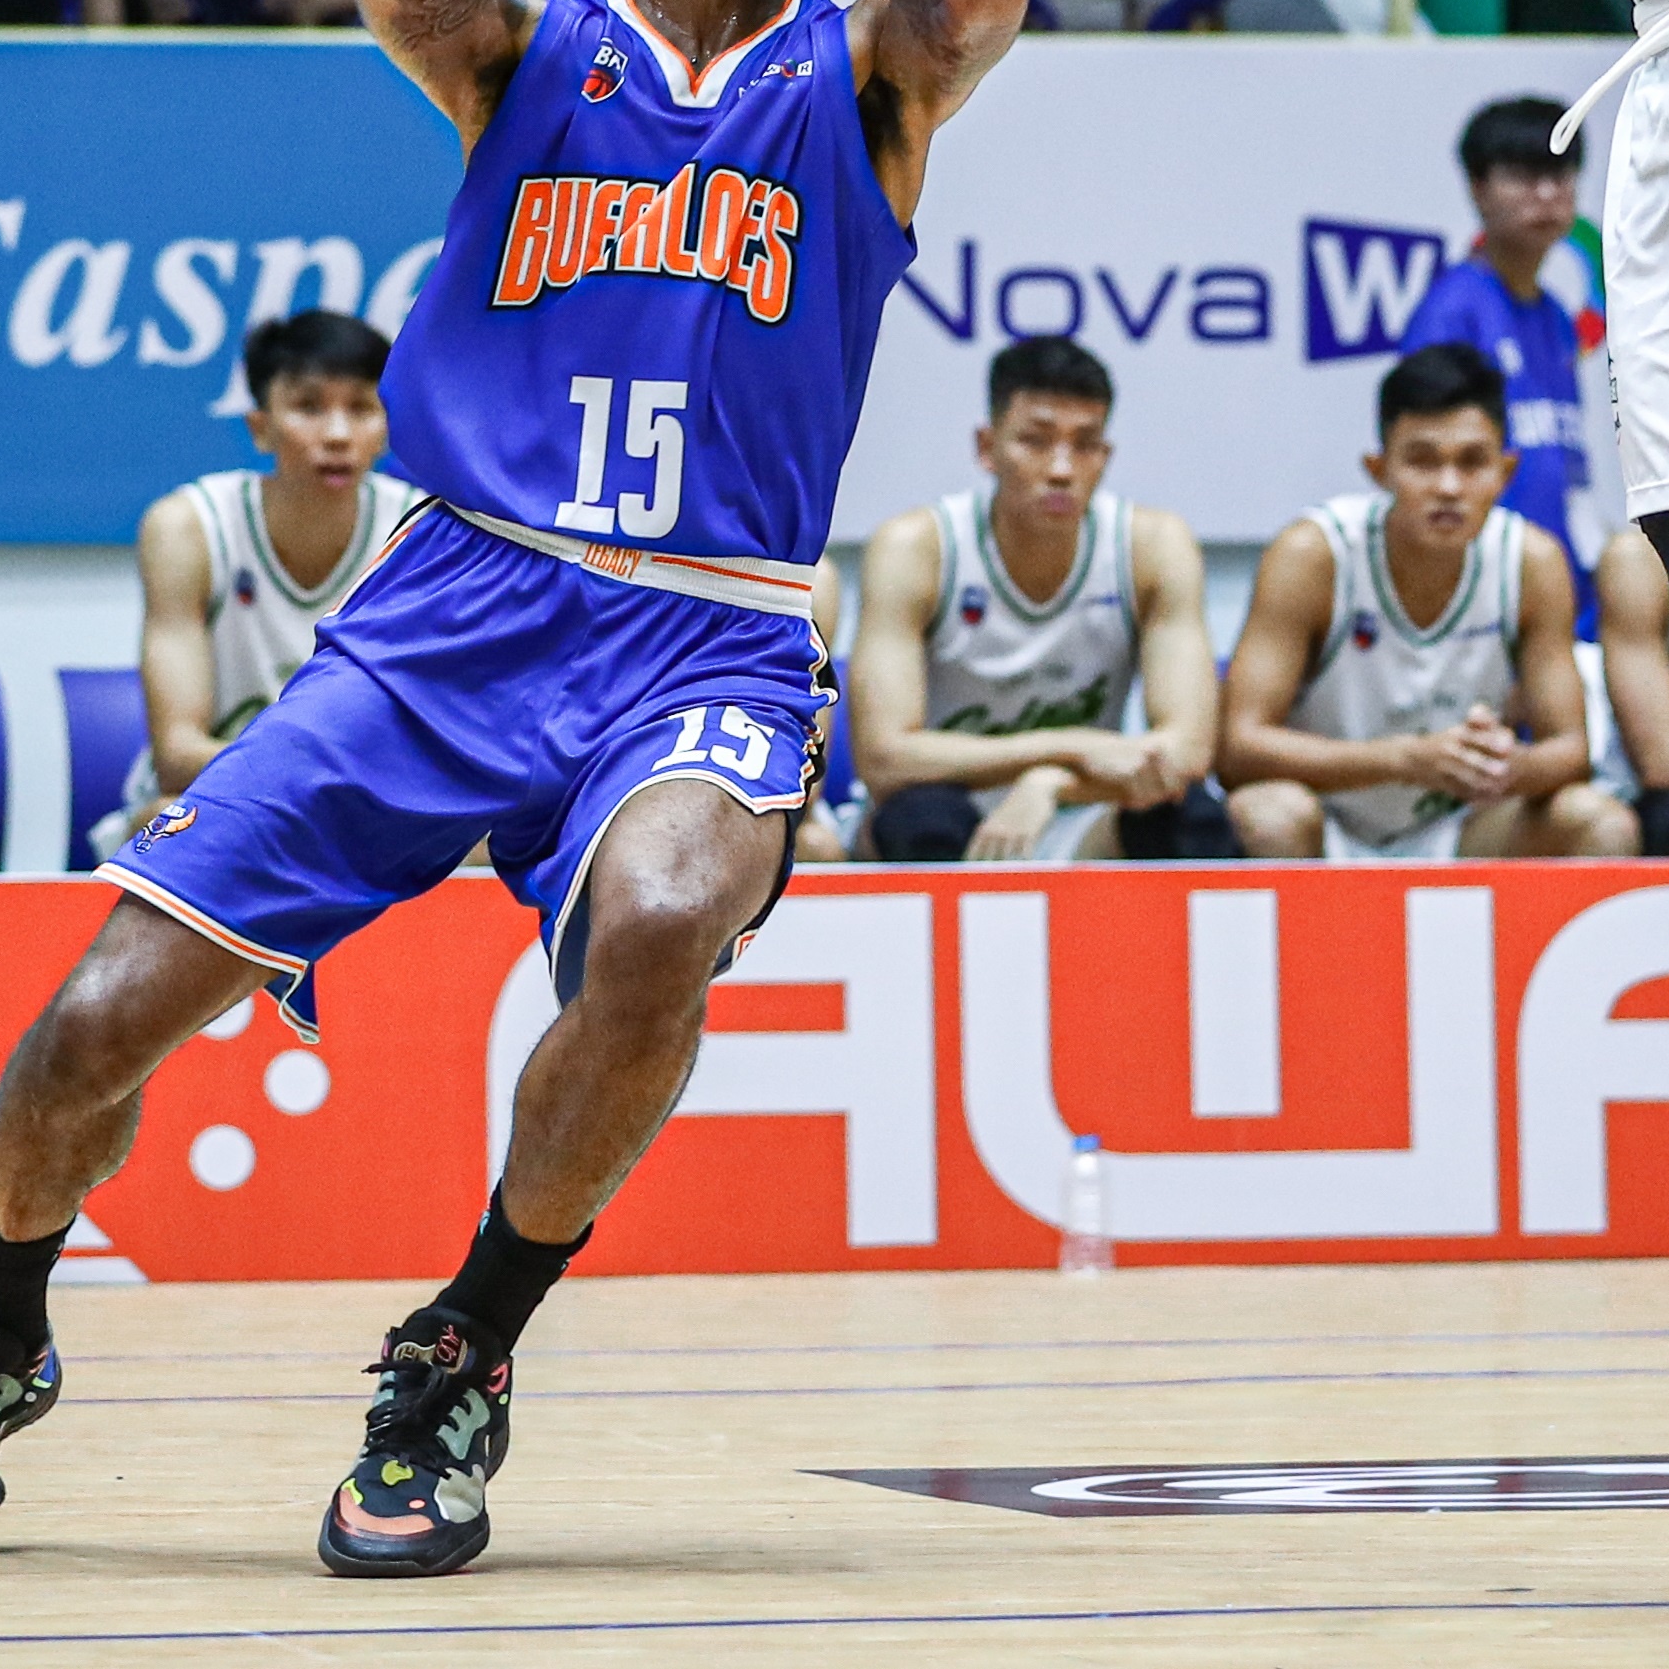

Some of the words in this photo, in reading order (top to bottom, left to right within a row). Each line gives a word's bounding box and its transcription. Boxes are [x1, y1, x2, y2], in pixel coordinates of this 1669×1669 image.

[553, 374, 690, 540] 15
[581, 539, 643, 580] LEGACY
[650, 705, 776, 781] 15
